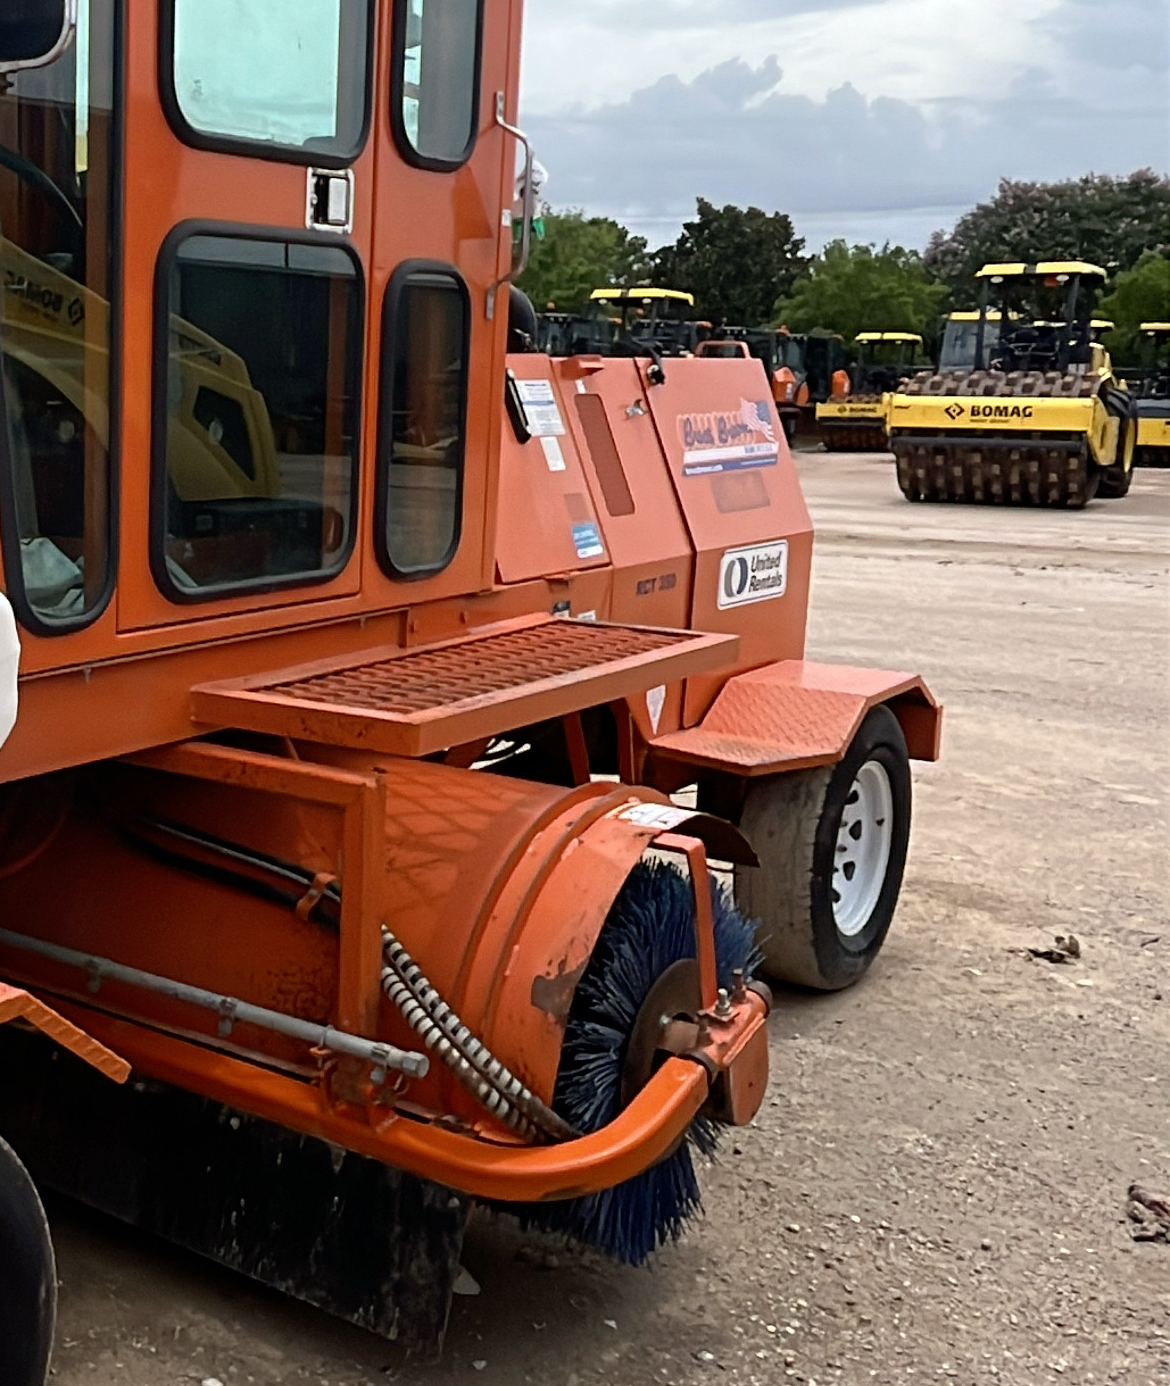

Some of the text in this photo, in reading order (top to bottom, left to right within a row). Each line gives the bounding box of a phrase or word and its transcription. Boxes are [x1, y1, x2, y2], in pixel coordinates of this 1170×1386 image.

[970, 405, 1033, 418] BOMAG
[751, 551, 782, 573] United
[748, 573, 782, 593] Rentals
